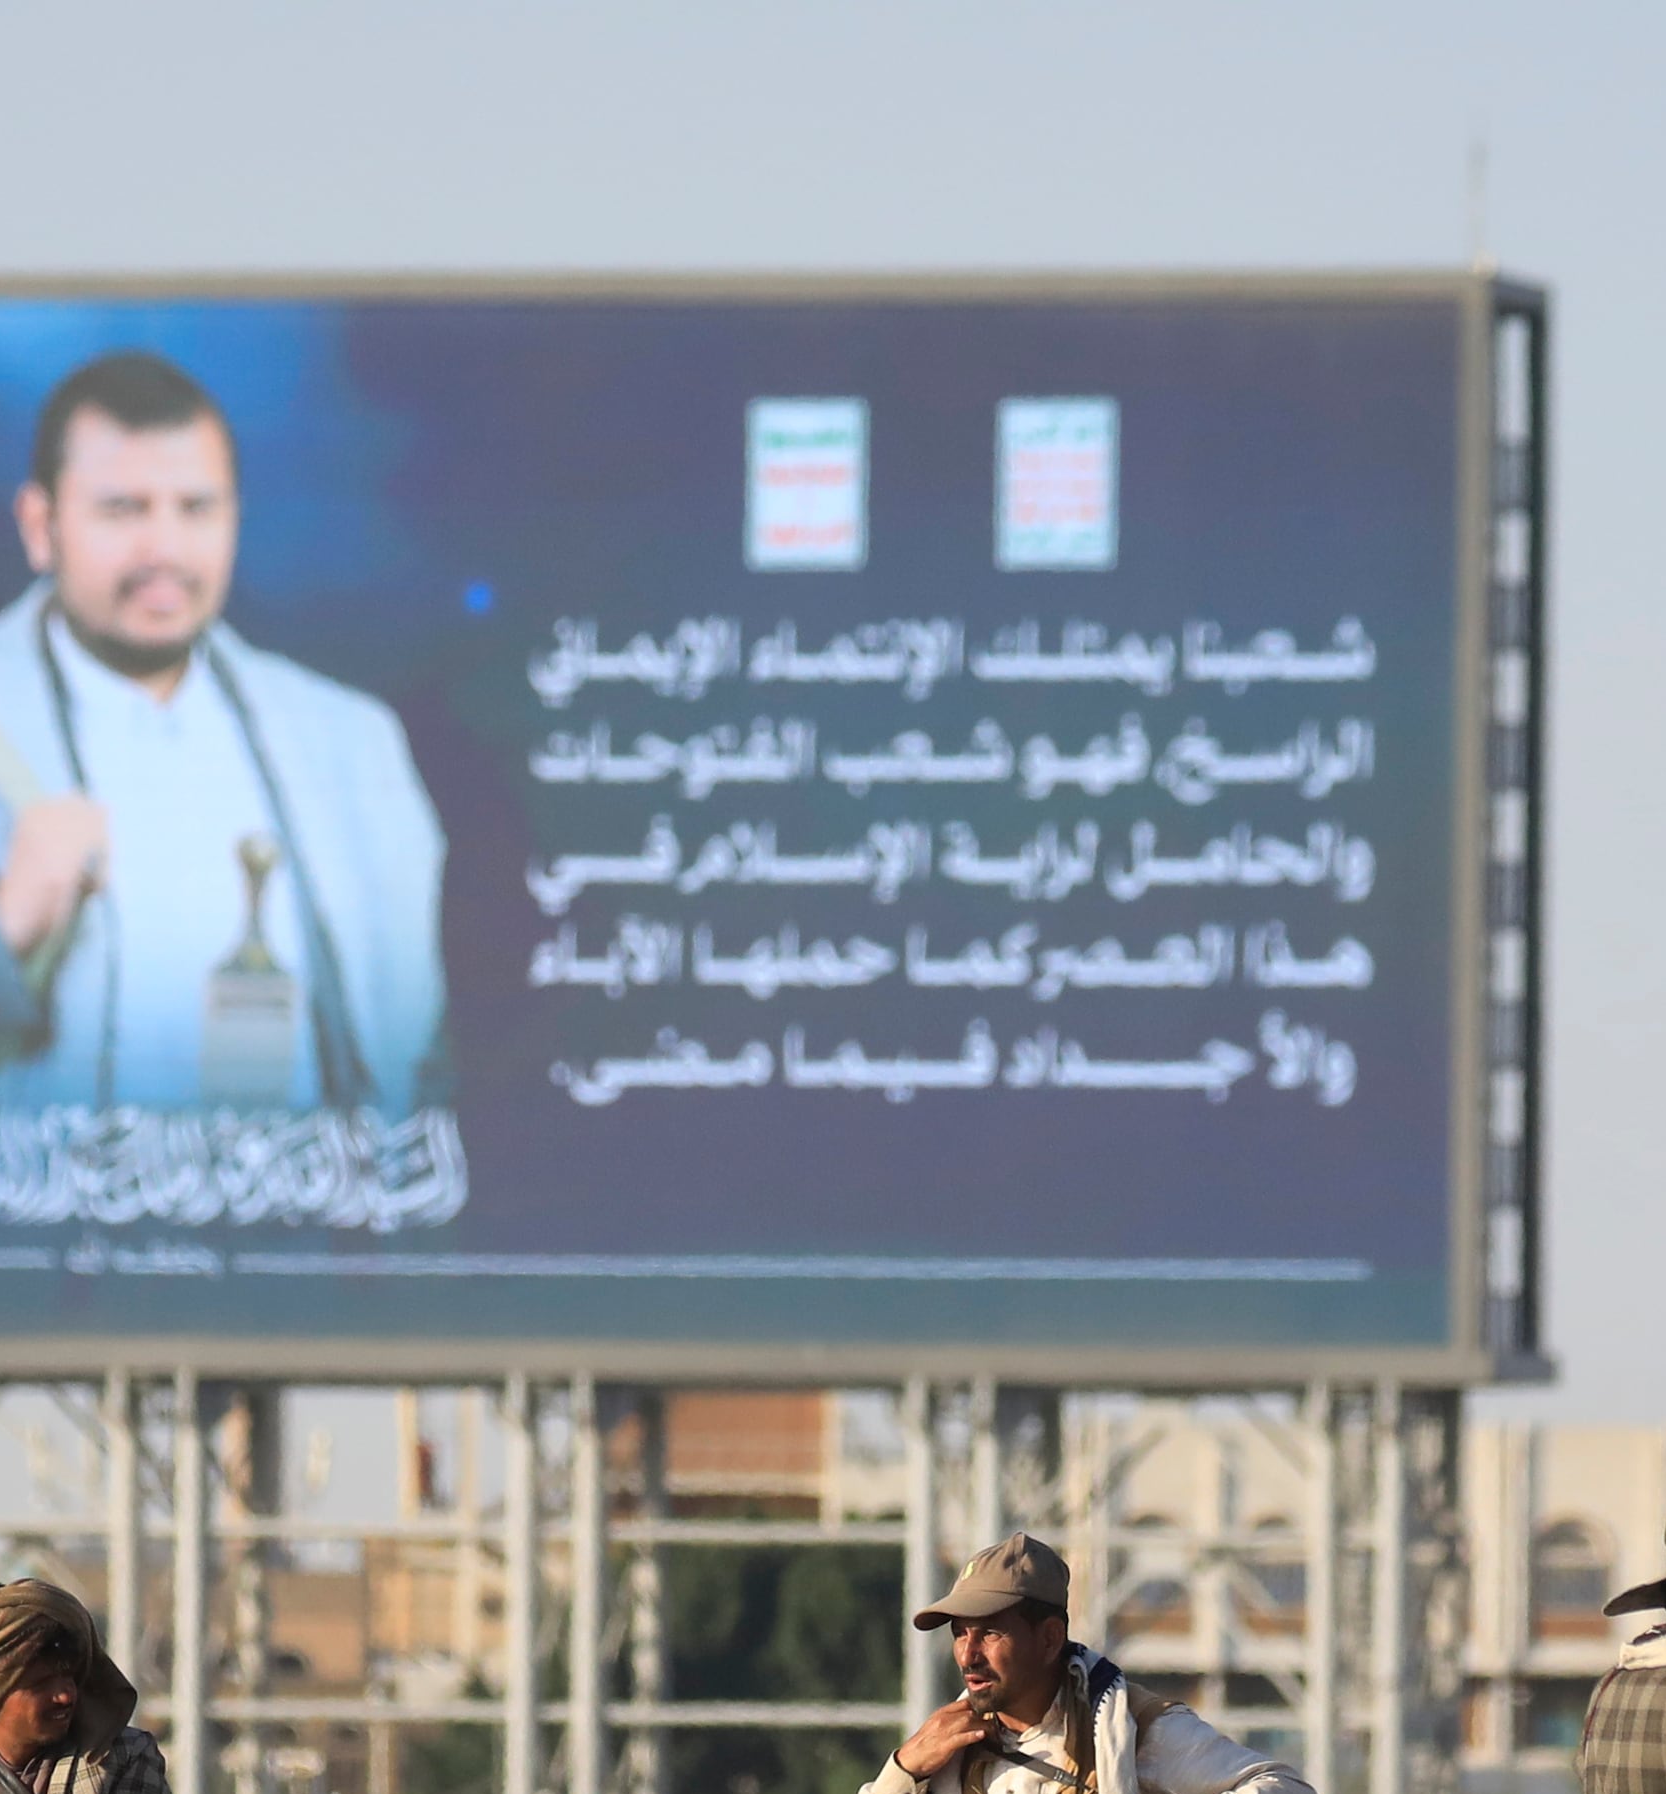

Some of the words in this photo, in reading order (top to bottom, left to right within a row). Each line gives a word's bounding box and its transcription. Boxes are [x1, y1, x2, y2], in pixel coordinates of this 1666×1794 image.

[1183, 617, 1376, 694] شعبنا
[529, 715, 817, 800] الفتوحات
[822, 718, 1015, 797] شعب
[1018, 713, 1150, 800] فهو
[1153, 718, 1375, 805] الراسخ
[525, 814, 680, 918] في
[677, 820, 932, 904] الإسلام
[939, 820, 1100, 901] لراية
[1104, 820, 1376, 902] والحامل
[692, 925, 898, 1000] حملها
[905, 923, 1037, 992] كما
[1033, 924, 1235, 1001] العصر
[1243, 922, 1374, 989] هذا
[783, 1018, 998, 1103] فيما
